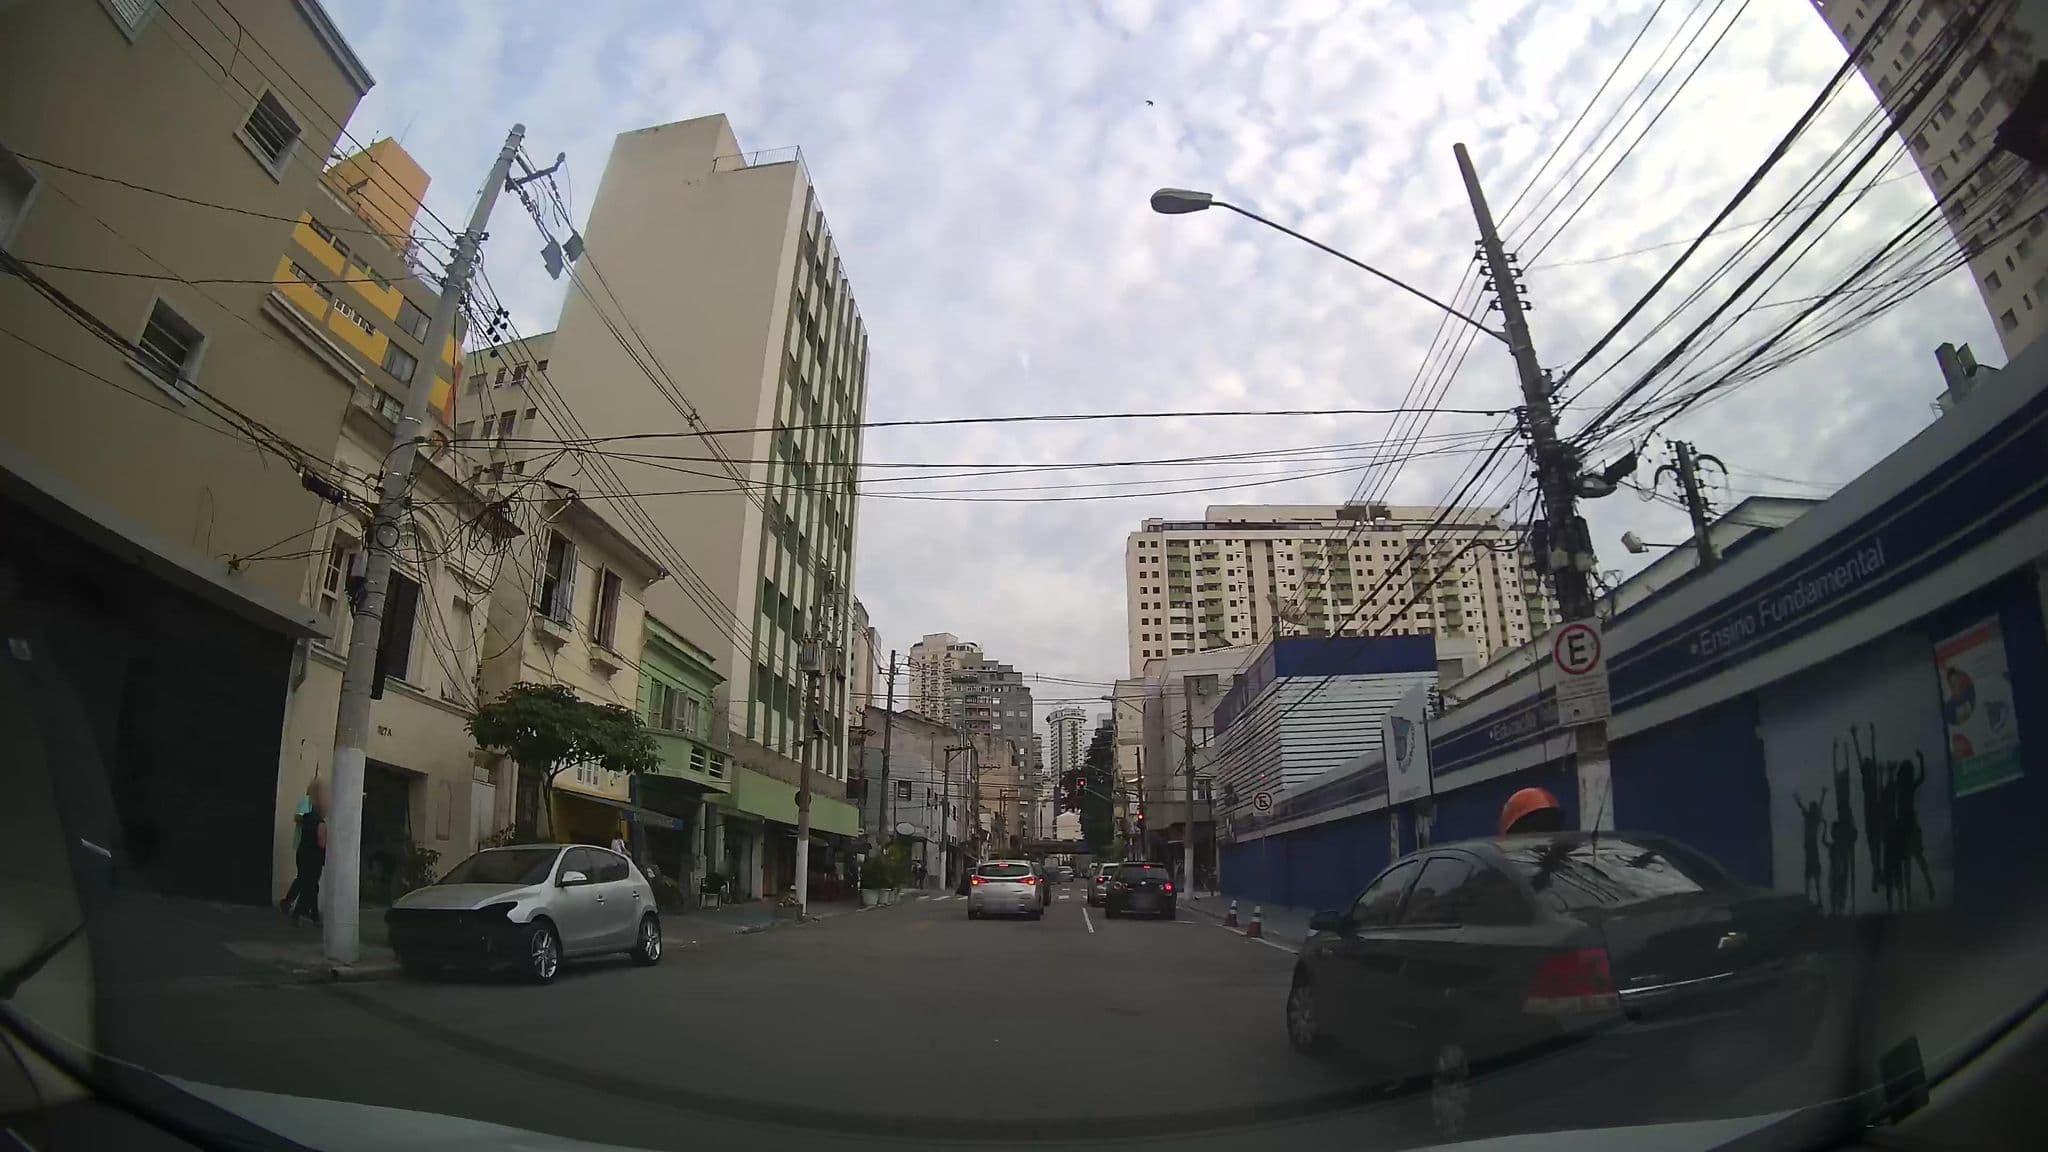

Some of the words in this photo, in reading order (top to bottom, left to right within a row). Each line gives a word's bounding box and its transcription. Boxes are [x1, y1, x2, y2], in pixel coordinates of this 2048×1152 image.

[1699, 616, 1755, 655] Ensino
[1759, 537, 1885, 627] Fundamental
[1567, 633, 1588, 666] E
